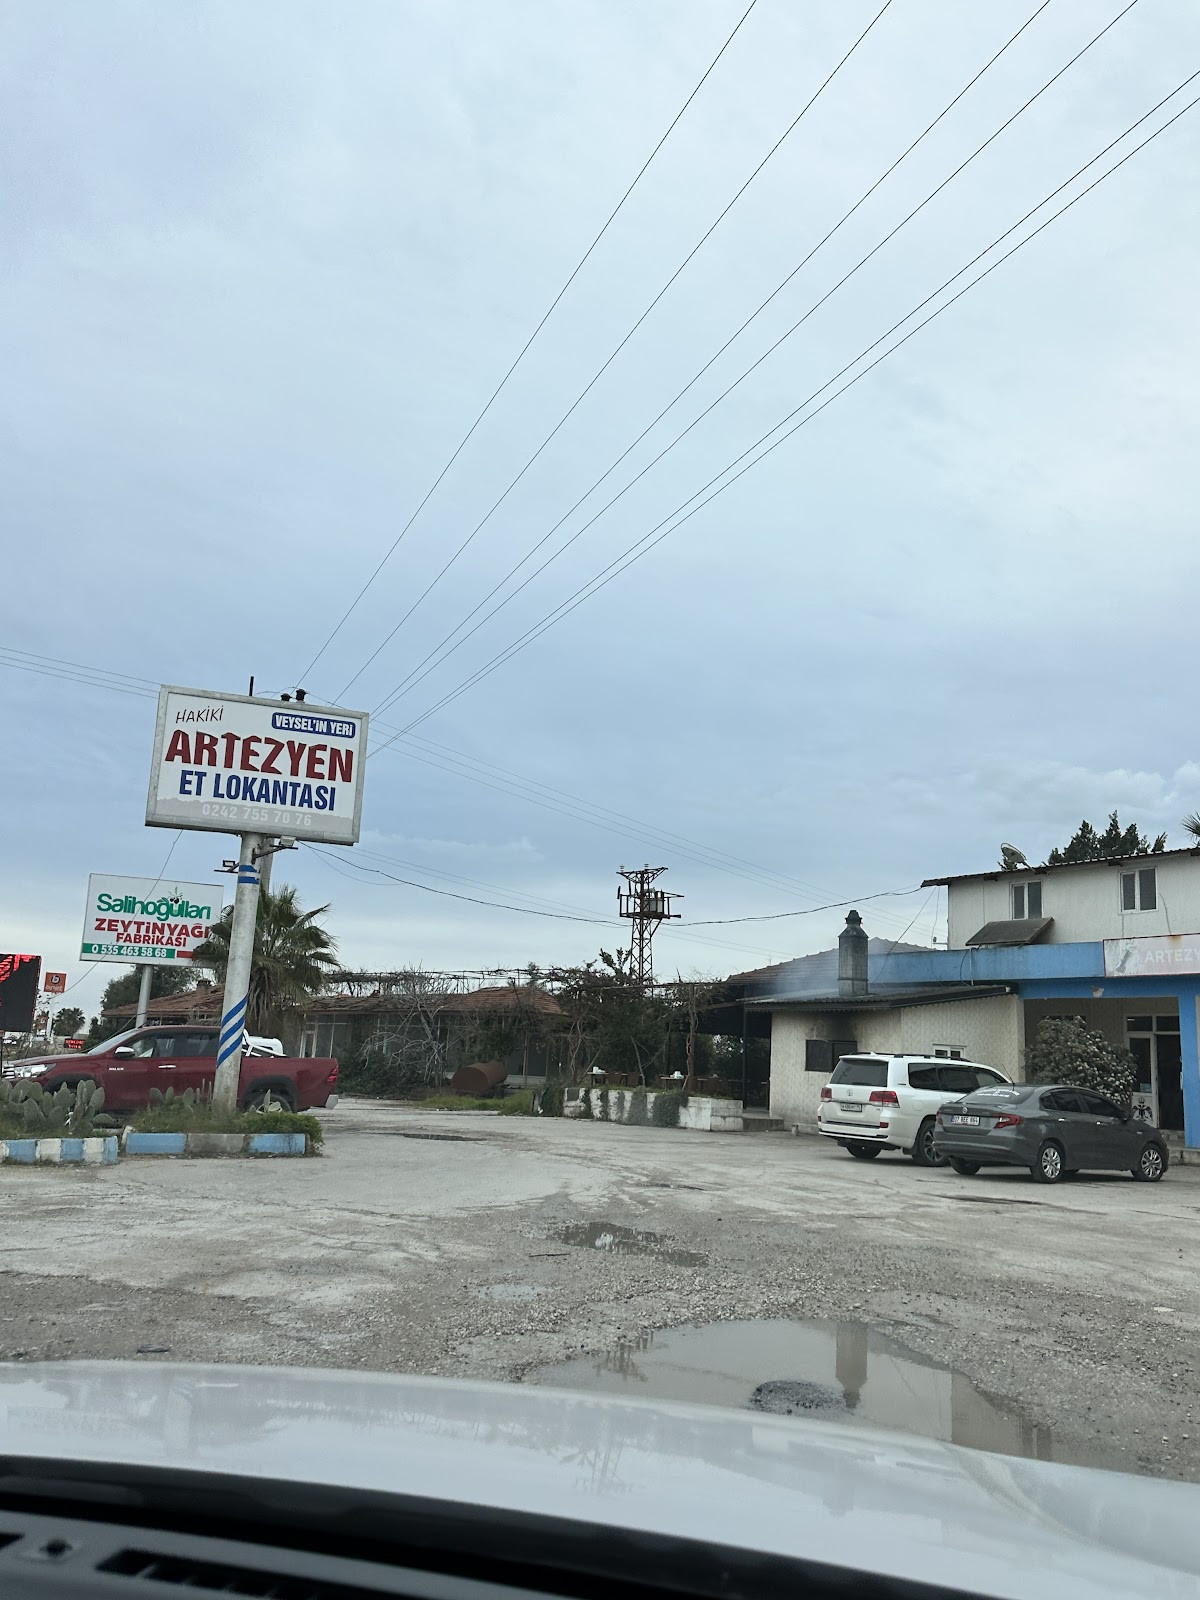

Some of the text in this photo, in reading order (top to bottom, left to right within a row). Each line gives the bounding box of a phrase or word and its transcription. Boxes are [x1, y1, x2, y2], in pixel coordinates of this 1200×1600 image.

[175, 705, 224, 724] HAKİKİ
[165, 729, 354, 783] ARTEZYEN
[179, 769, 336, 811] ET LOKANTASI
[202, 803, 312, 827] 0242 755 70 76
[91, 945, 167, 958] 0 535 463 58 68
